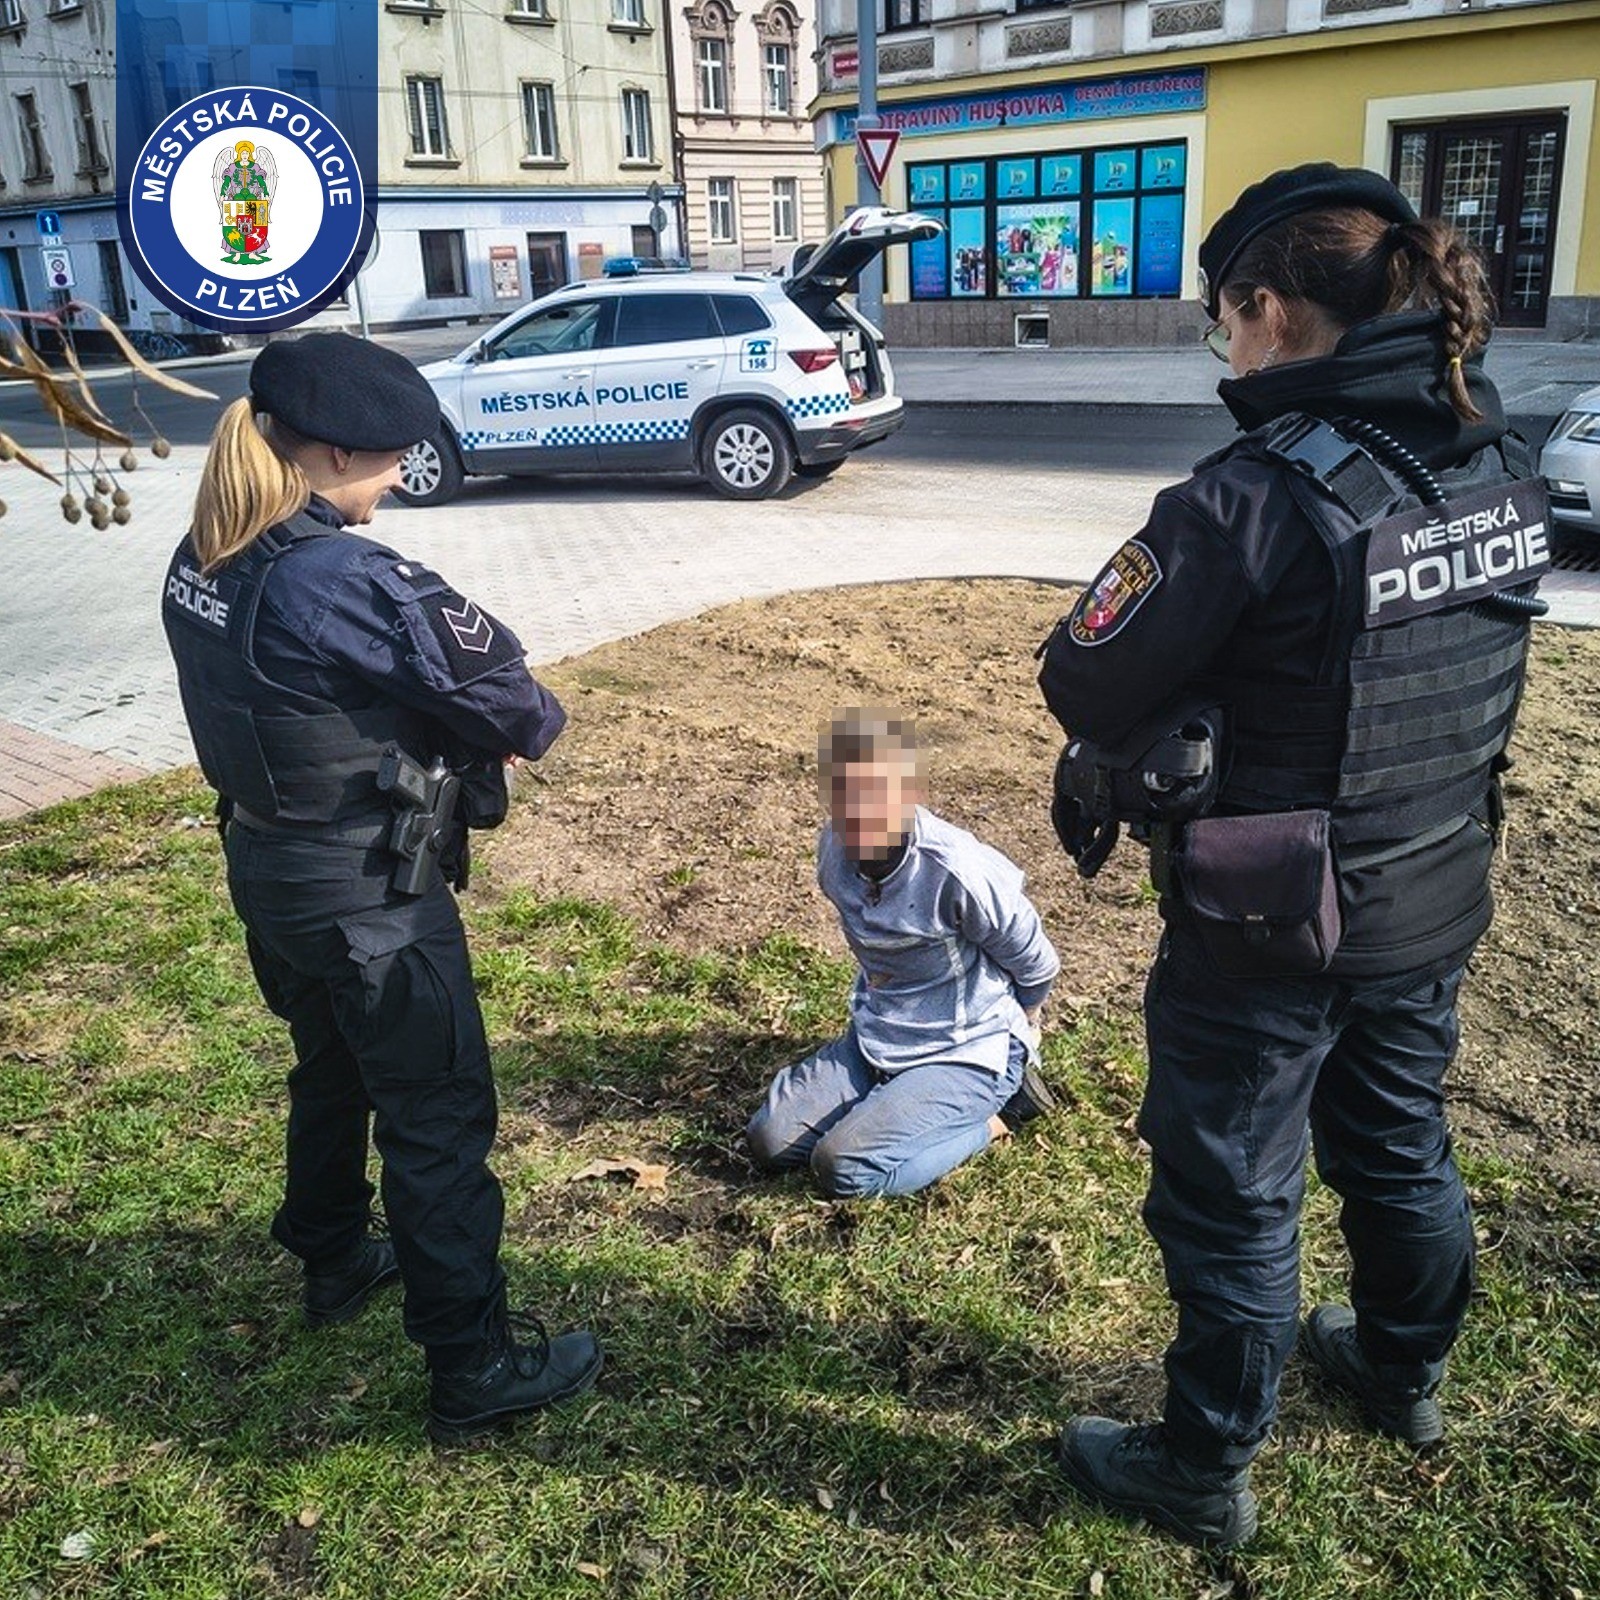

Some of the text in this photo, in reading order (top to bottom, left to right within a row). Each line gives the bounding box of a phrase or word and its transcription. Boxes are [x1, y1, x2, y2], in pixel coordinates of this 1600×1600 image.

[968, 92, 1066, 122] HUSOVKA
[747, 357, 768, 370] 156
[480, 381, 690, 415] MĚSTSKÁ POLICIE
[485, 427, 538, 444] PLZEŇ
[1401, 498, 1521, 556] MĚSTSKÁ
[1367, 522, 1551, 616] POLICIE
[166, 575, 229, 628] POLICIE
